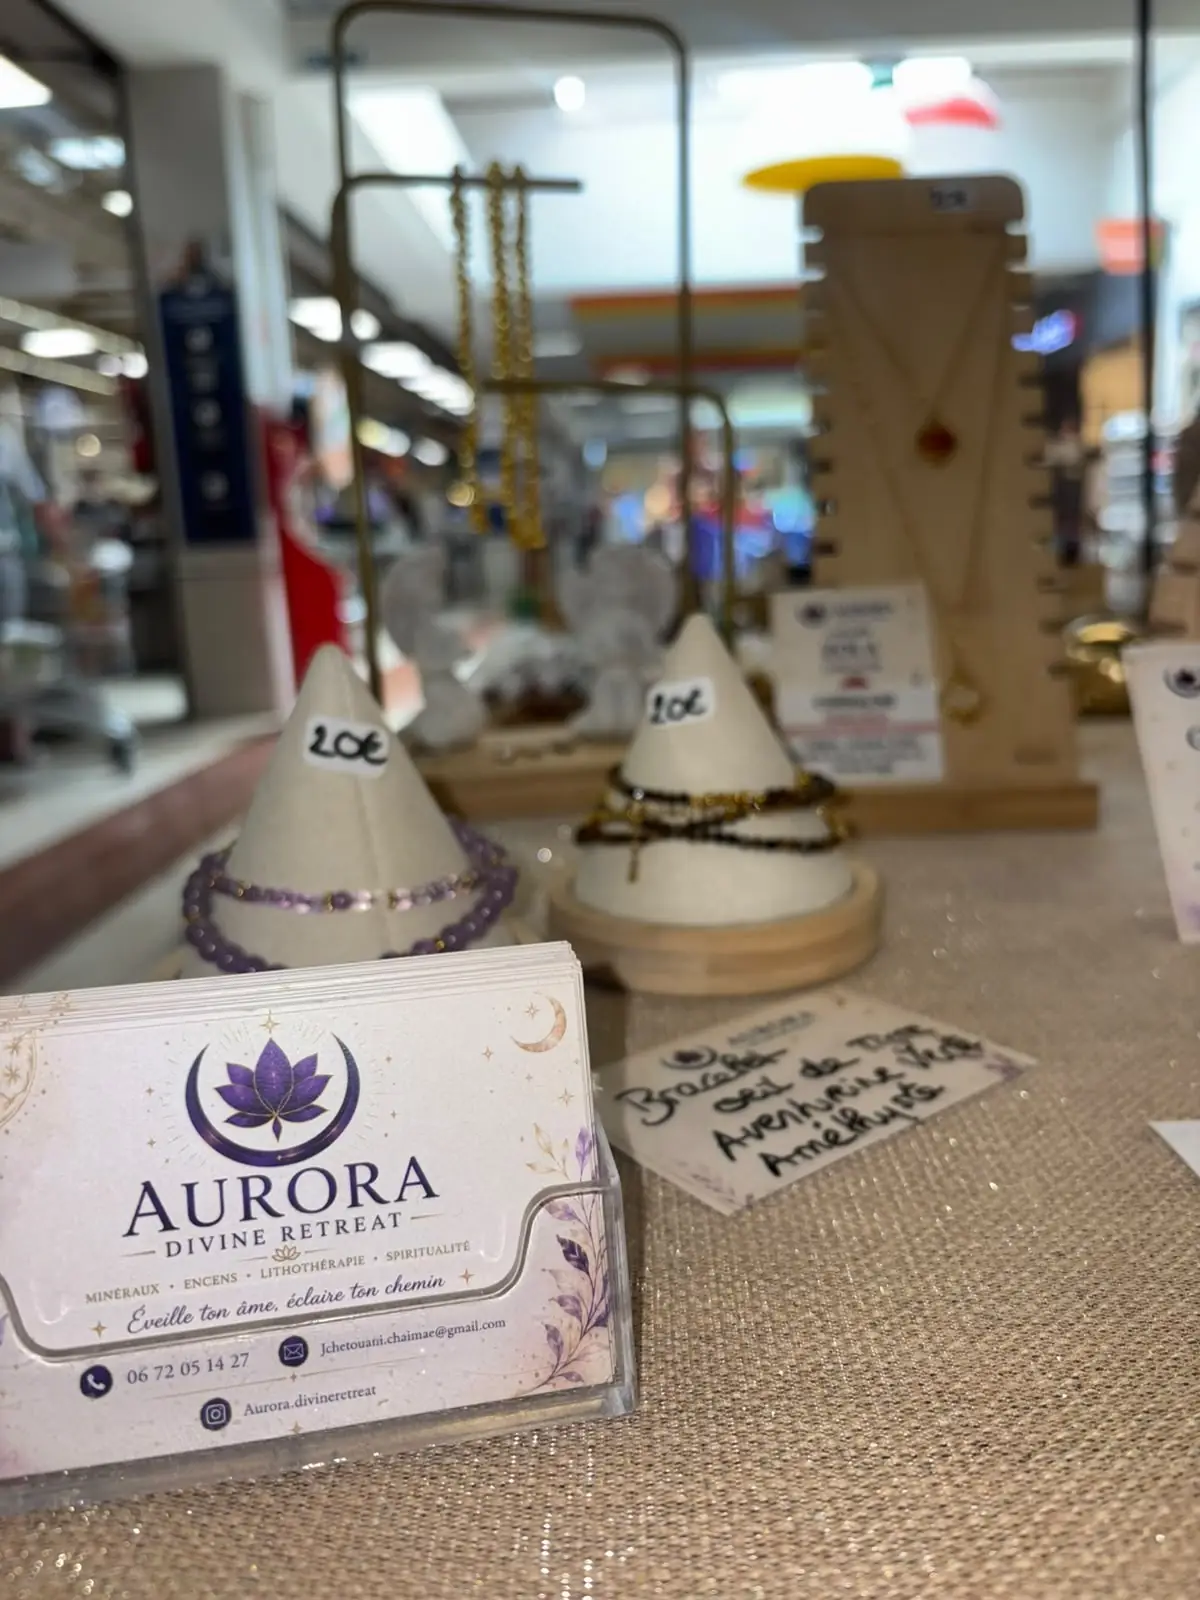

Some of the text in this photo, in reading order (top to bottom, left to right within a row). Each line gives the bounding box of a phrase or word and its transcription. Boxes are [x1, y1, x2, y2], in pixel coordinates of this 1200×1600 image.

[649, 687, 709, 726] 20€
[308, 724, 389, 767] 20€
[757, 1082, 946, 1178] Améthyste
[122, 1156, 440, 1238] AURORA
[165, 1211, 403, 1257] DIVINE RETREAT
[85, 1240, 471, 1304] MINÉRAUX ENCENS LITHOTHÉRAPIE SPIRITUALITÉ
[127, 1274, 447, 1335] Éveille ton âme, éclaire ton chemin
[320, 1319, 507, 1357] Jchetouani.chaimae@gmail.com
[127, 1352, 250, 1385] 06 72 05 14 27
[243, 1385, 378, 1417] Aurora.divineretreat
